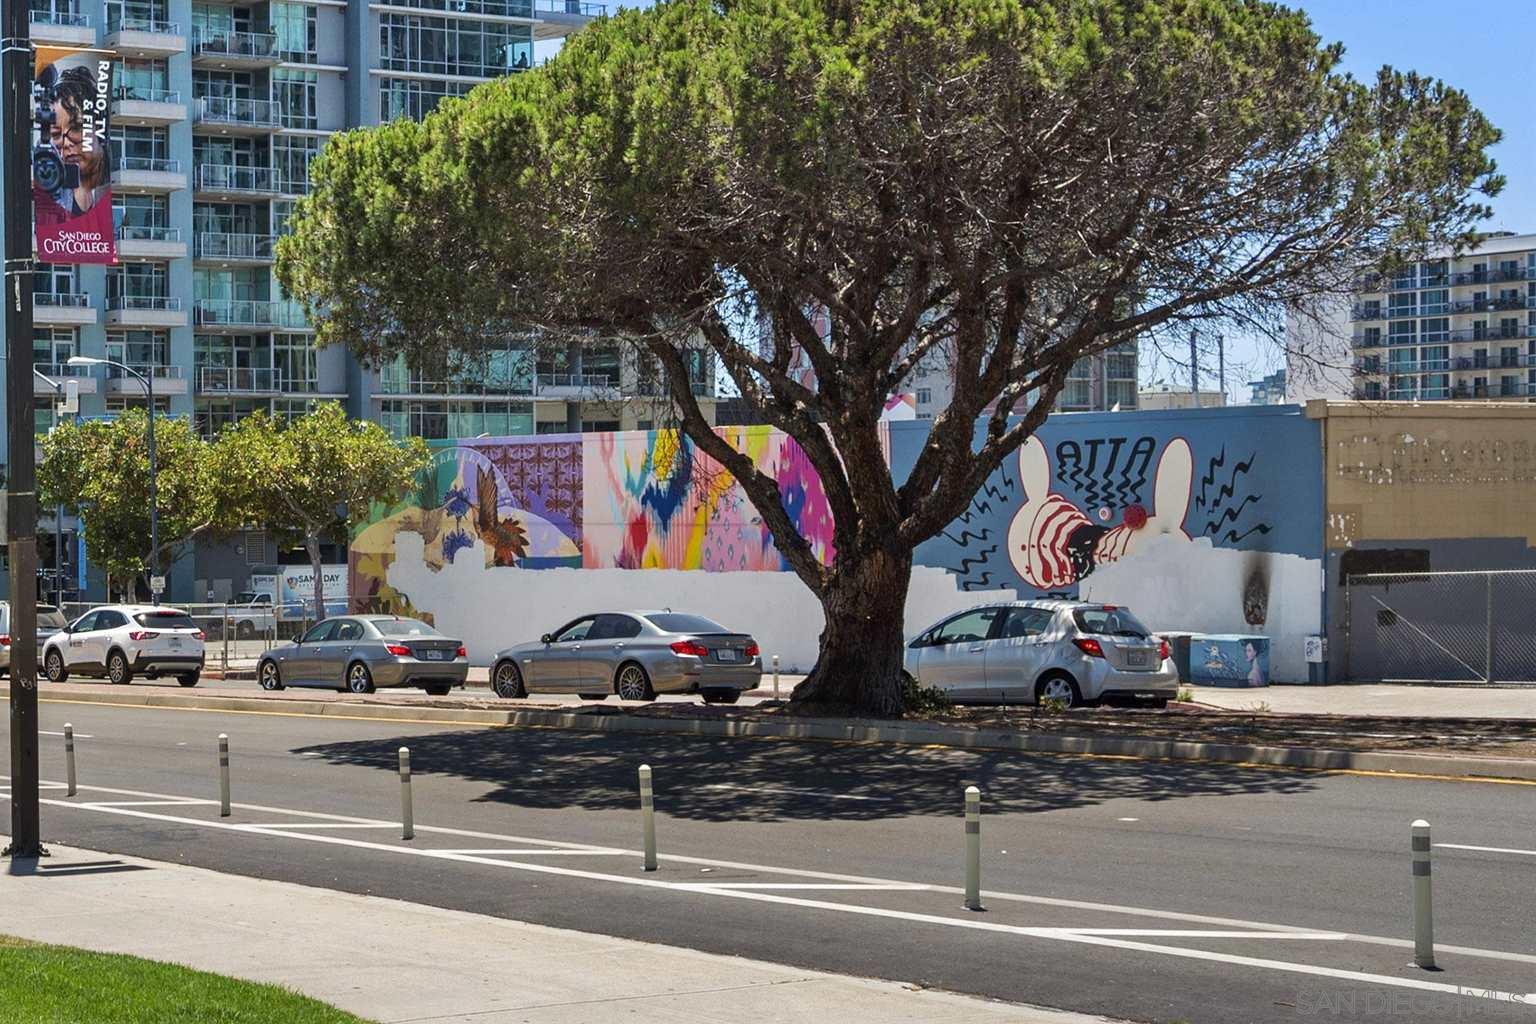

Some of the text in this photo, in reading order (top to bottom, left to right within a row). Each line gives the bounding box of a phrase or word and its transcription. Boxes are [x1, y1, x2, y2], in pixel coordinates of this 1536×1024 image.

[82, 99, 93, 152] & FILM
[95, 60, 110, 140] RADIO, TV
[323, 574, 340, 583] DAY
